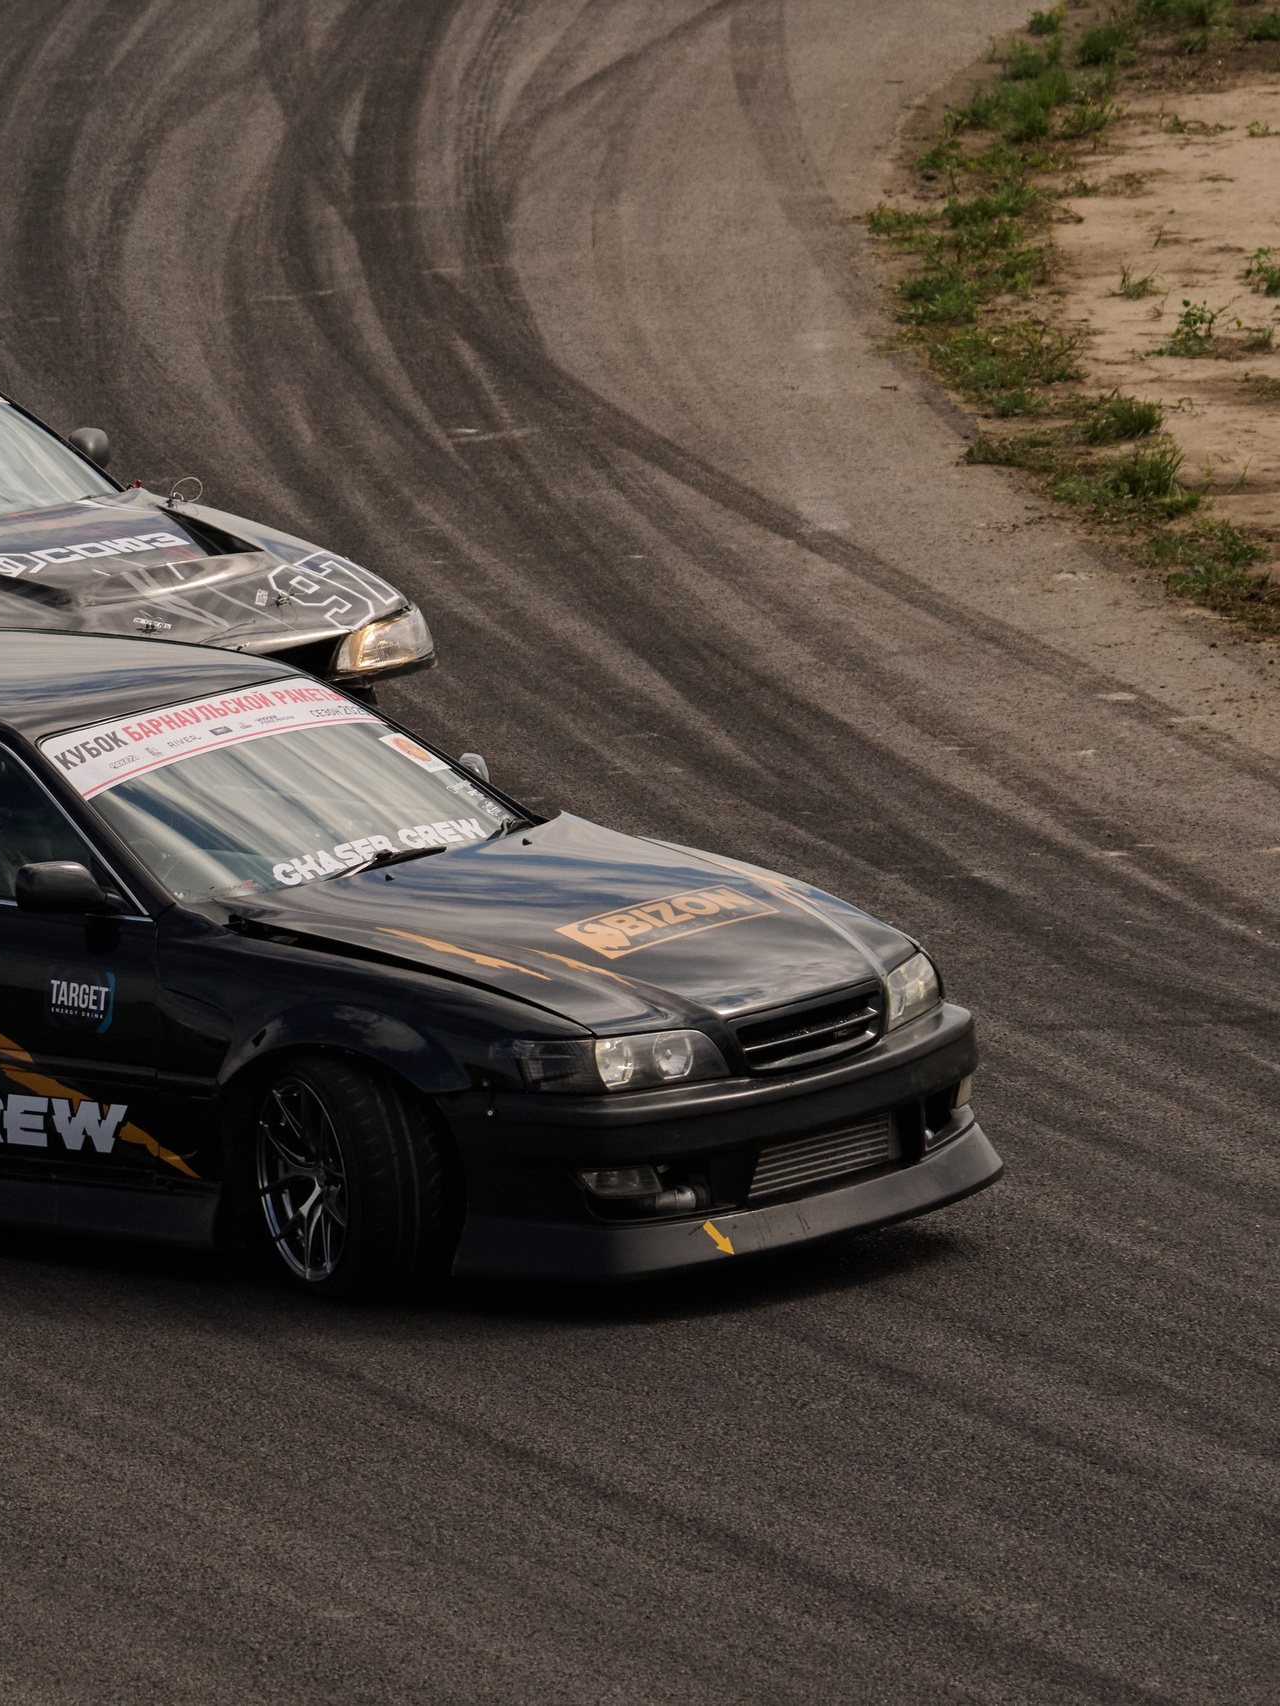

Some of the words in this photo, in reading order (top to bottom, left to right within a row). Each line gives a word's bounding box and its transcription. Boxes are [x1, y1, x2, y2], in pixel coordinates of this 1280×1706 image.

[267, 551, 401, 630] 97
[54, 730, 129, 771] КУБОК
[121, 690, 277, 743] БАРНАУЛЬСКОЙ
[271, 688, 348, 705] РАКЕТЫ
[310, 708, 342, 718] СЕЗОН
[167, 735, 202, 749] RIVER
[272, 834, 401, 886] CHASER
[398, 818, 488, 849] CREW
[600, 888, 755, 937] BIZON
[51, 979, 109, 1011] TARGET
[51, 1007, 78, 1016] ENERGY
[81, 1011, 104, 1020] DRINK
